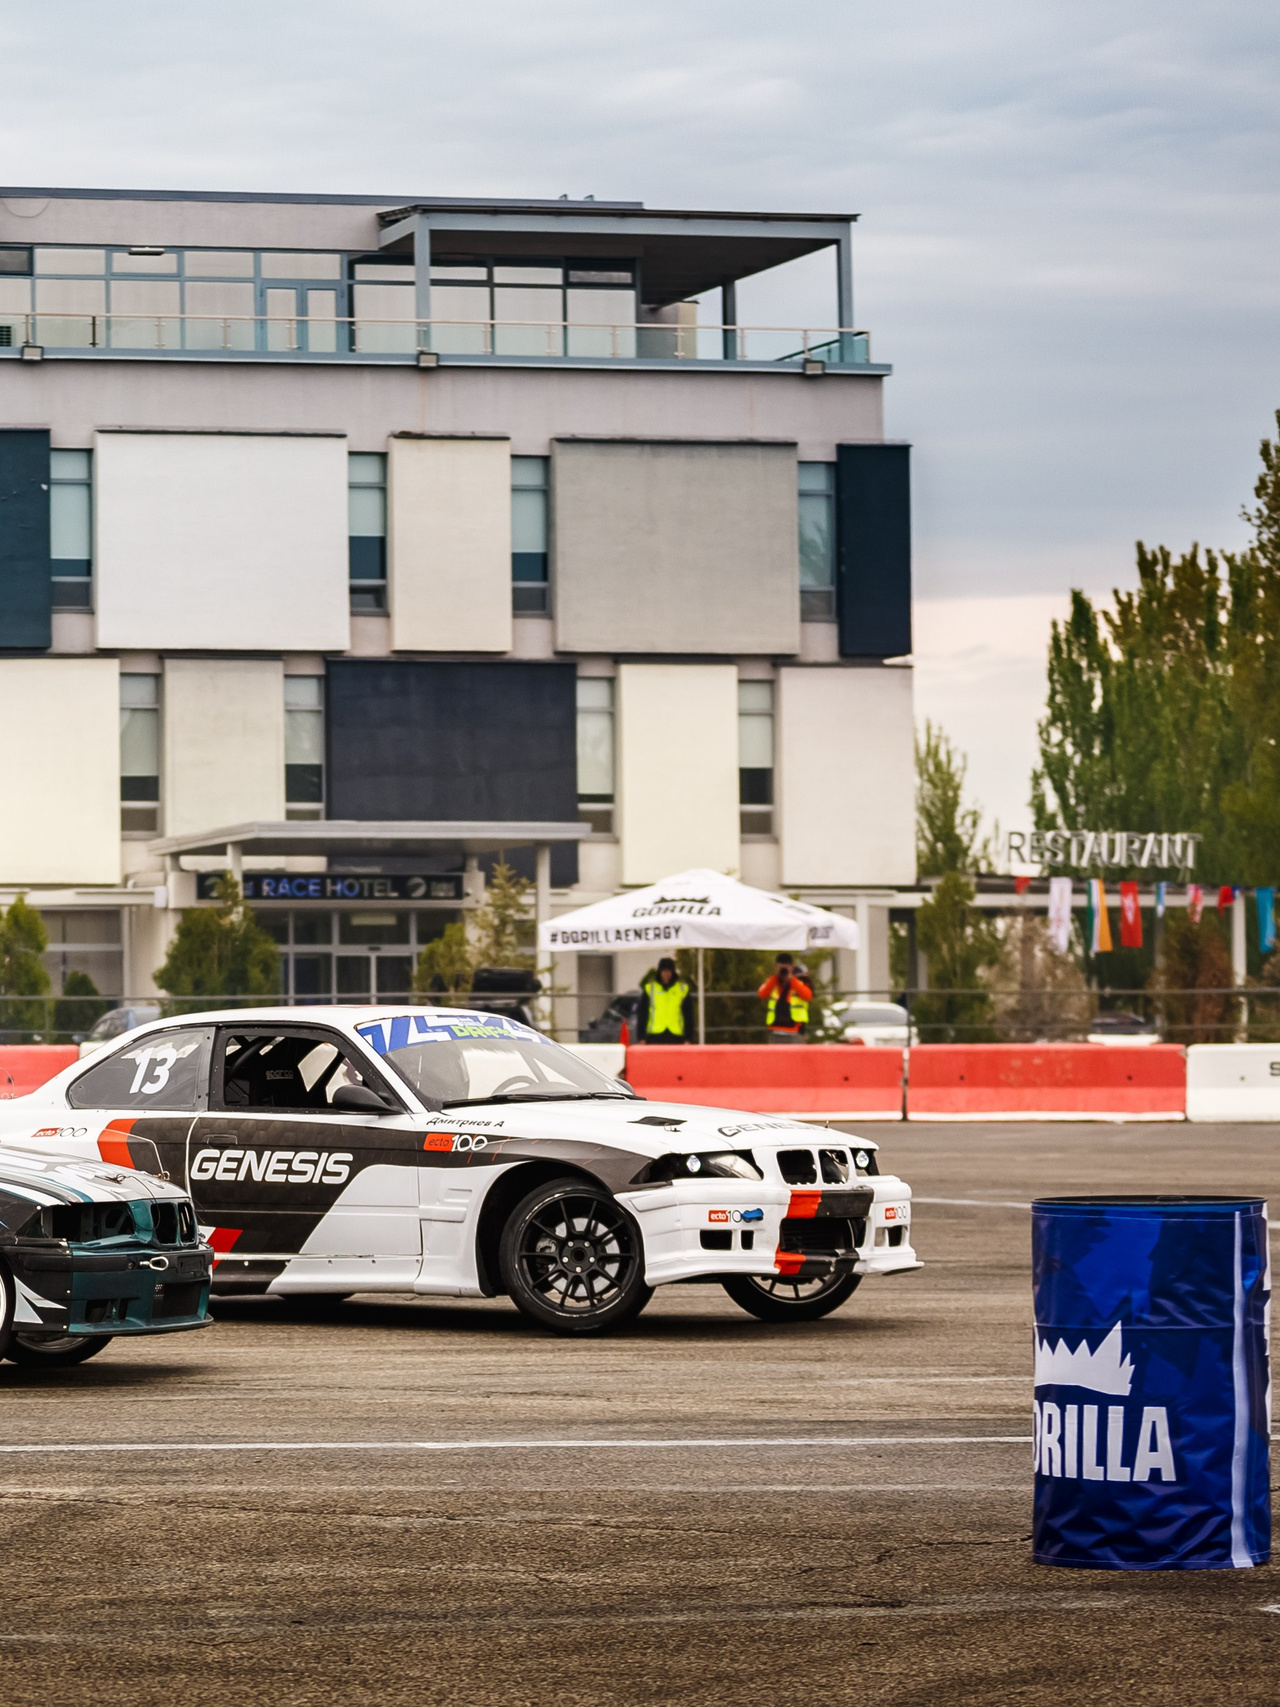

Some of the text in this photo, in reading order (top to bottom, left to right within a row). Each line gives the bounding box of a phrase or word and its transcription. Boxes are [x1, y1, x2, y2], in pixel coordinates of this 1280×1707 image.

[1007, 830, 1204, 868] RESTAURANT
[261, 878, 320, 897] RACE
[326, 878, 399, 897] HOTEL
[632, 904, 721, 917] GORILLA
[129, 1047, 177, 1094] 13
[190, 1149, 353, 1185] GENESIS
